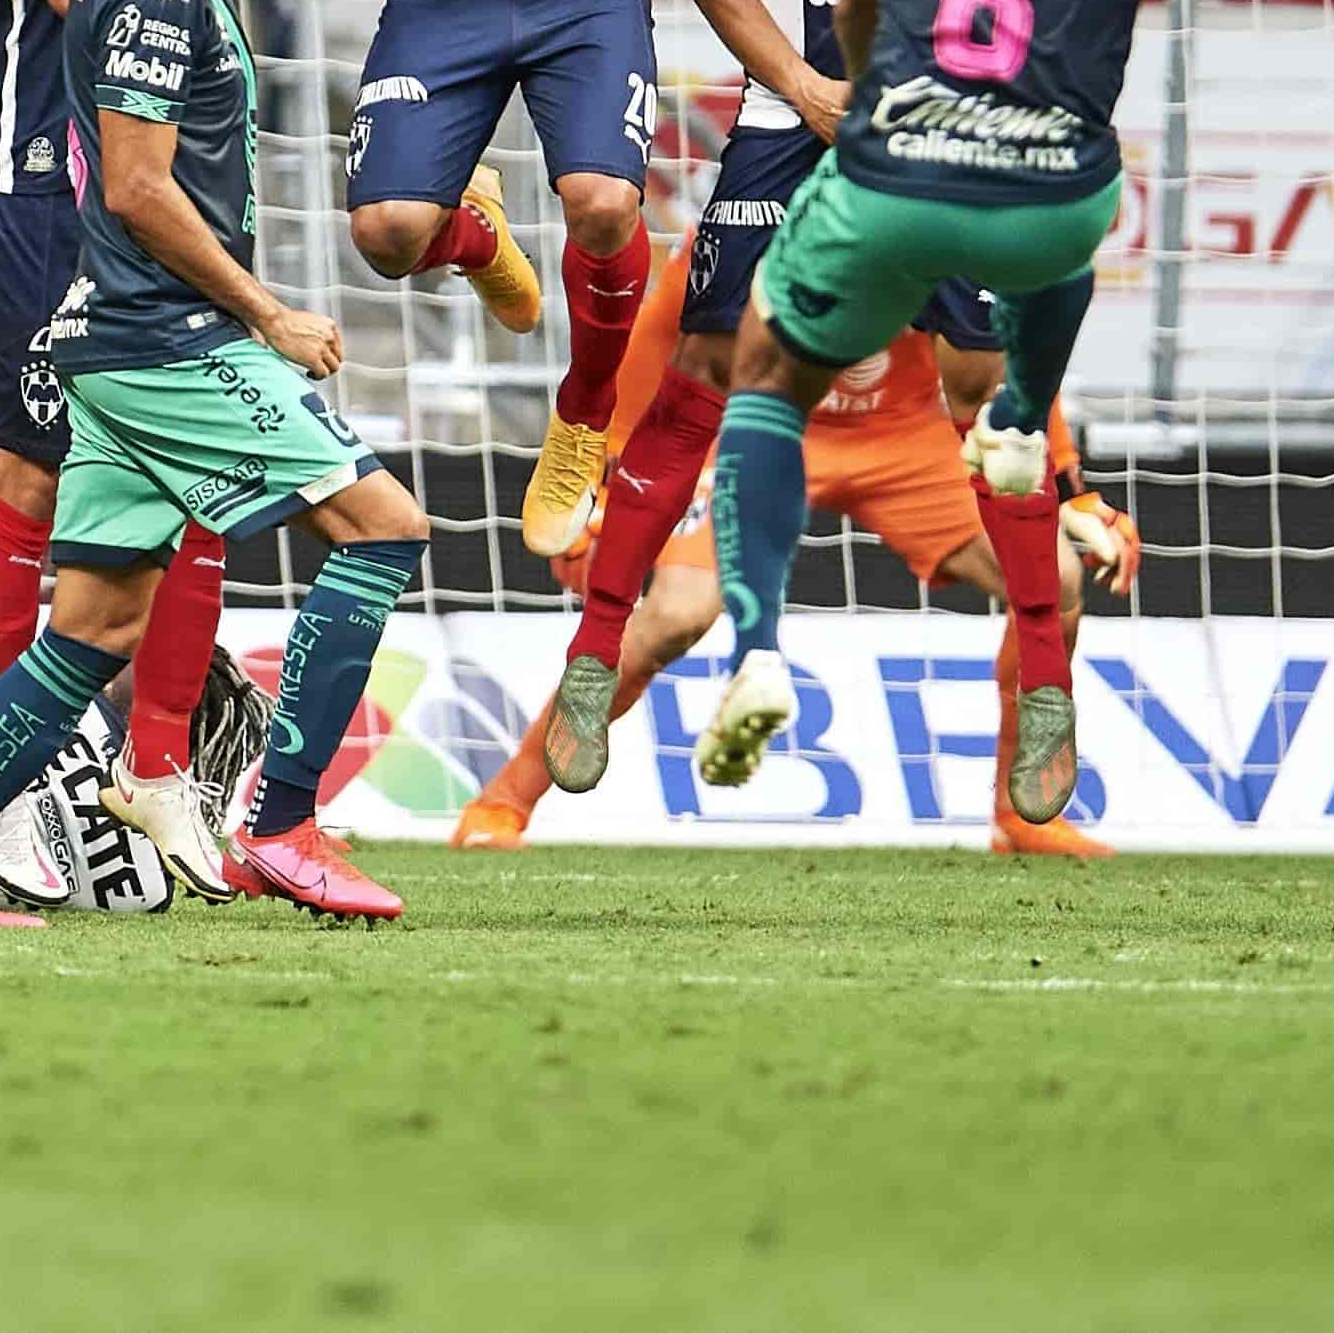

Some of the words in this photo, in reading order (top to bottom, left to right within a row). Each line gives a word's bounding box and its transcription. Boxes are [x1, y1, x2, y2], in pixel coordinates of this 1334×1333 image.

[105, 49, 185, 91] Mobil
[622, 72, 658, 135] 20
[887, 129, 1078, 171] caliente.mx
